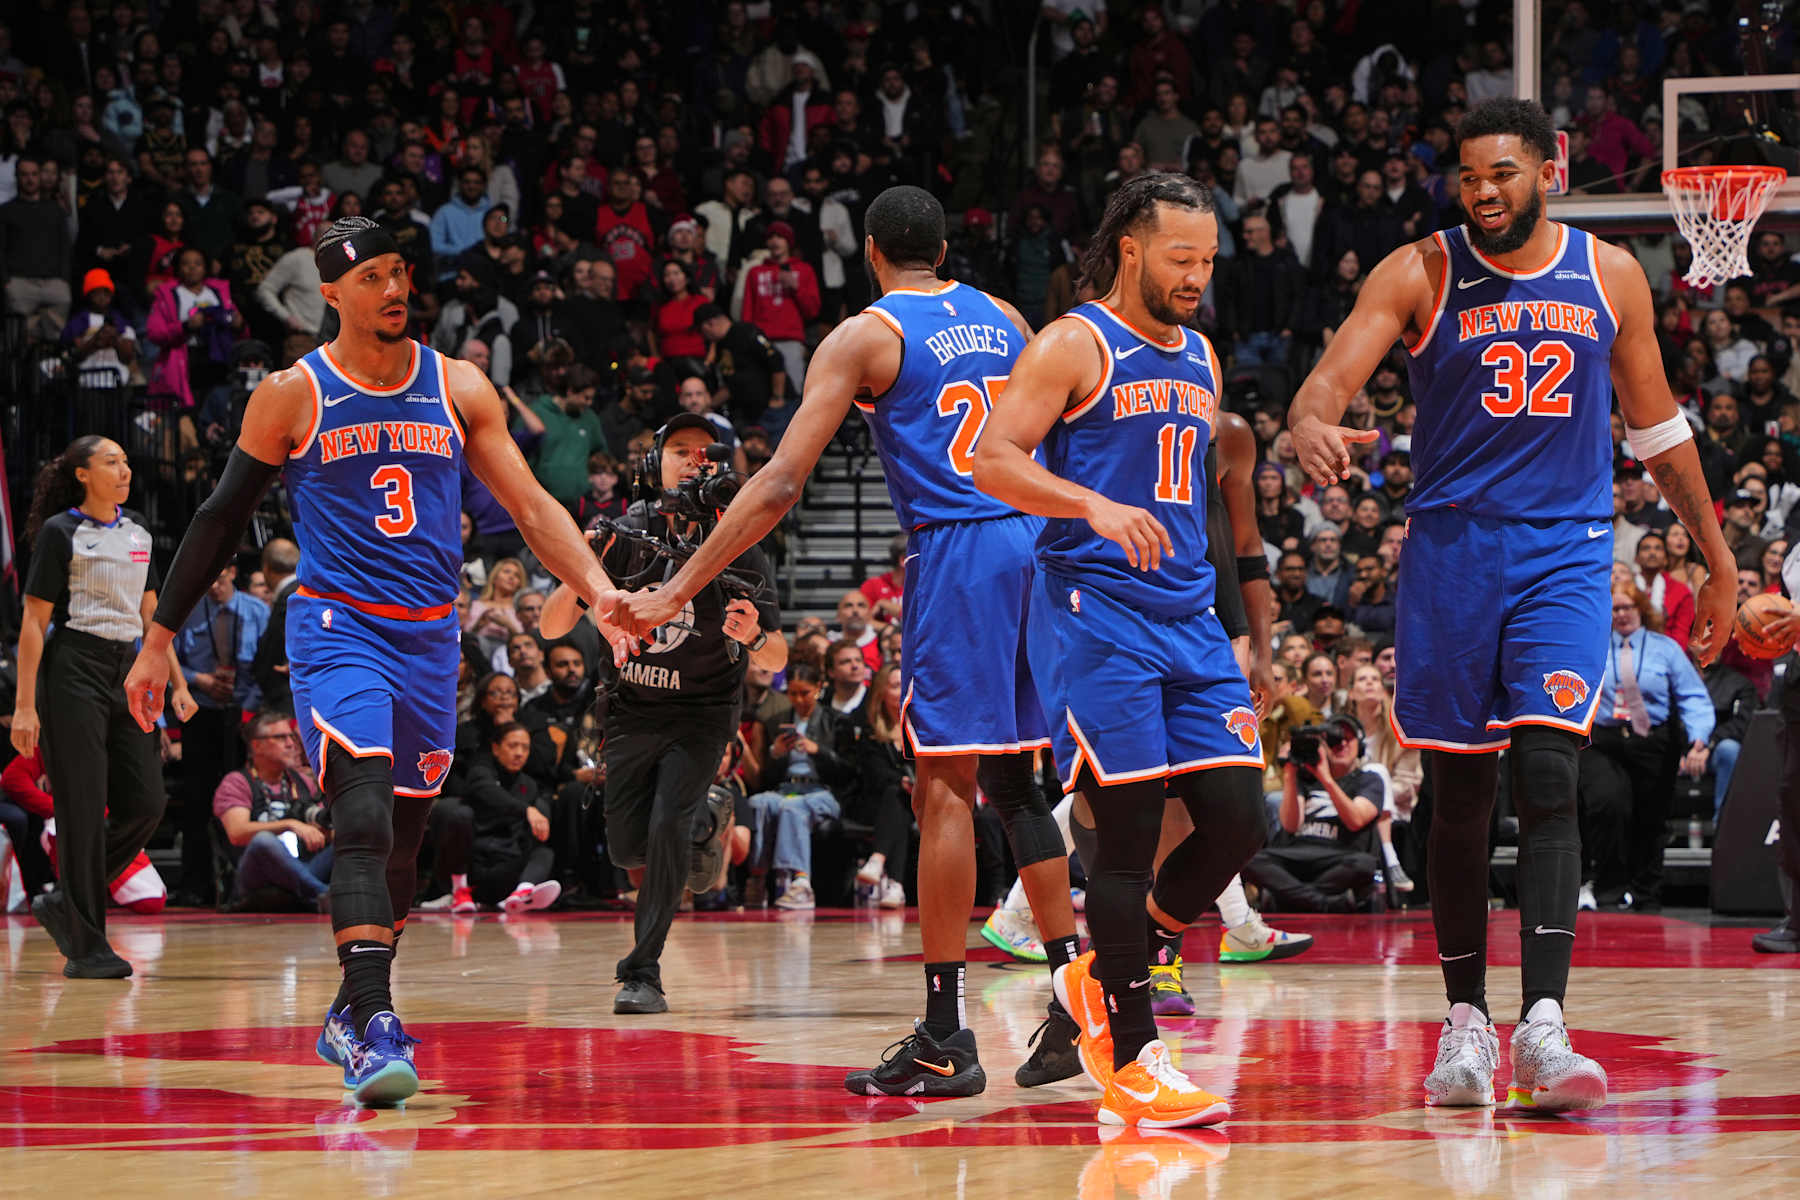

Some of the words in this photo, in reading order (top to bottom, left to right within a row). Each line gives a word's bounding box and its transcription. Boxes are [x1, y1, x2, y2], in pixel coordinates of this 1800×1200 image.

[1458, 302, 1523, 342] NEW
[1525, 300, 1599, 342] YORK
[925, 324, 1009, 366] BRIDGES
[1112, 379, 1172, 421] NEW
[1481, 340, 1575, 417] 32
[318, 421, 382, 465] NEW
[383, 421, 453, 459] YORK
[1155, 423, 1198, 505] 11
[370, 464, 417, 538] 3
[1545, 673, 1585, 700] KNICKS
